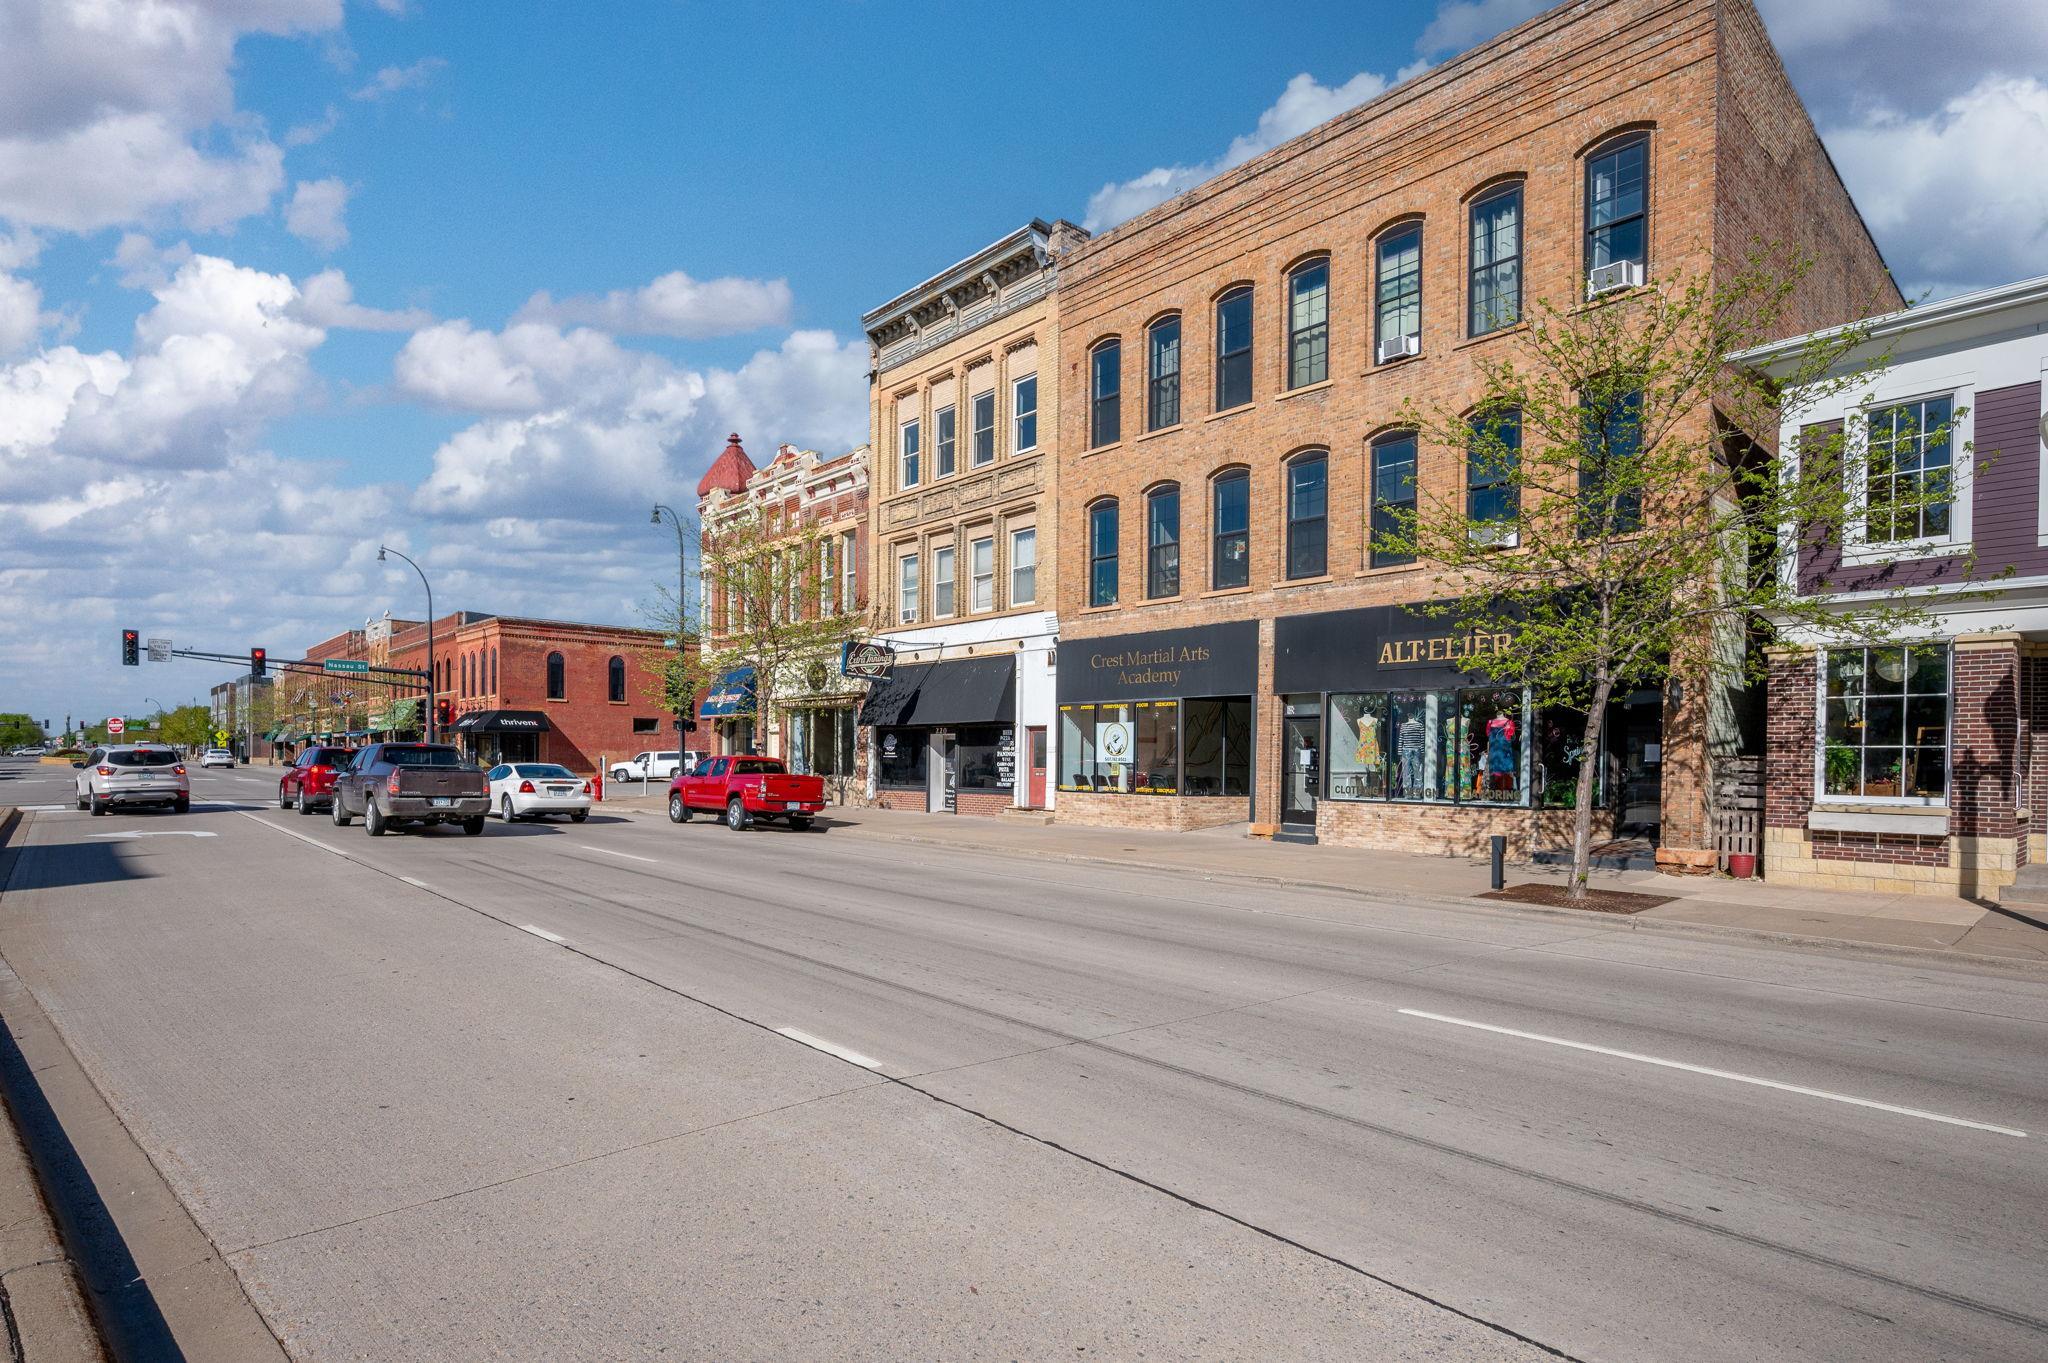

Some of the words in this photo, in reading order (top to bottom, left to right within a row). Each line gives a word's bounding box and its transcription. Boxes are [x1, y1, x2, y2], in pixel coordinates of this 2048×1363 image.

[848, 654, 866, 665] Extra
[1091, 654, 1123, 668] Crest
[1127, 647, 1174, 666] Martial
[1179, 646, 1210, 662] Arts
[1118, 668, 1181, 687] Academy
[500, 718, 539, 726] thrivent
